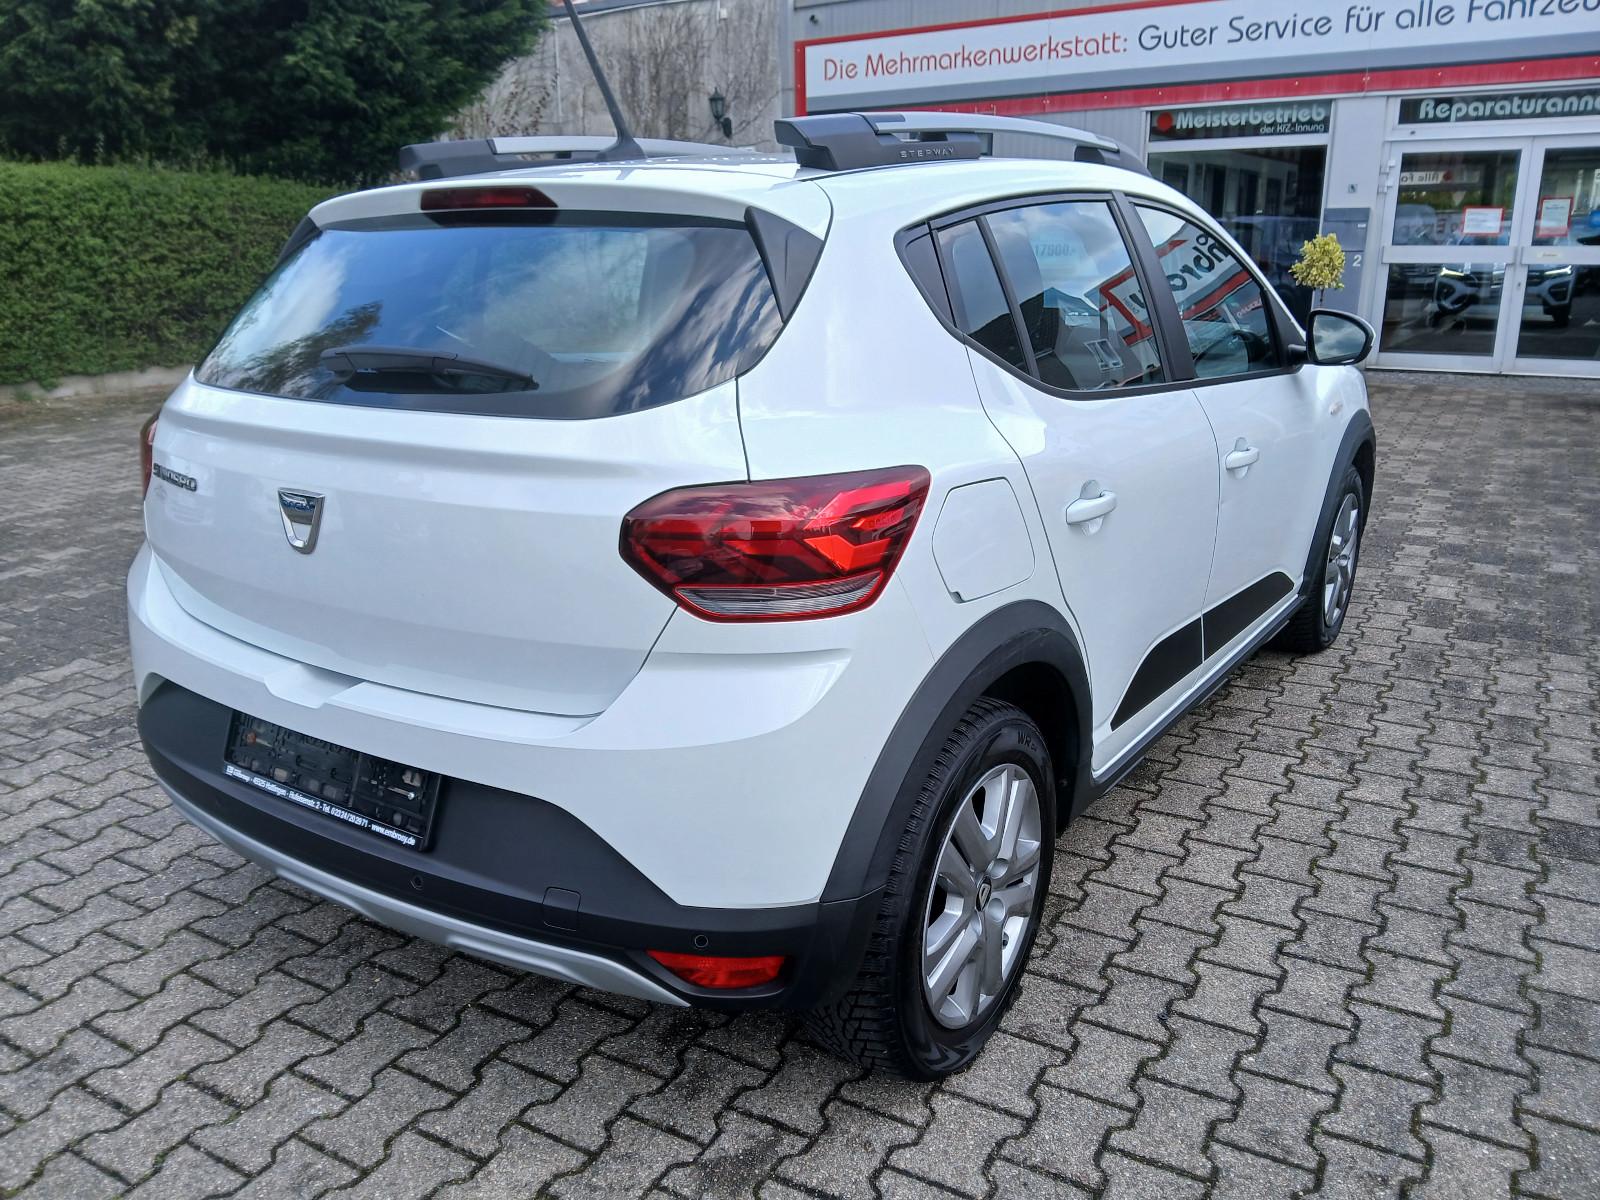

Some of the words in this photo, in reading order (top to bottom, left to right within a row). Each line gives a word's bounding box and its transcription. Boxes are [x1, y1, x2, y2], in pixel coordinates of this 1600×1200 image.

[824, 58, 858, 81] Die
[864, 32, 1128, 78] Mehrmarkenwerkstatt:
[1138, 22, 1219, 51] Guter
[1227, 12, 1333, 43] Service
[1344, 5, 1386, 34] für
[1395, 0, 1455, 30] alle
[1176, 103, 1326, 130] Meisterbetrieb
[1260, 125, 1275, 134] der
[899, 147, 954, 158] STEPWAY
[1352, 254, 1362, 267] 2
